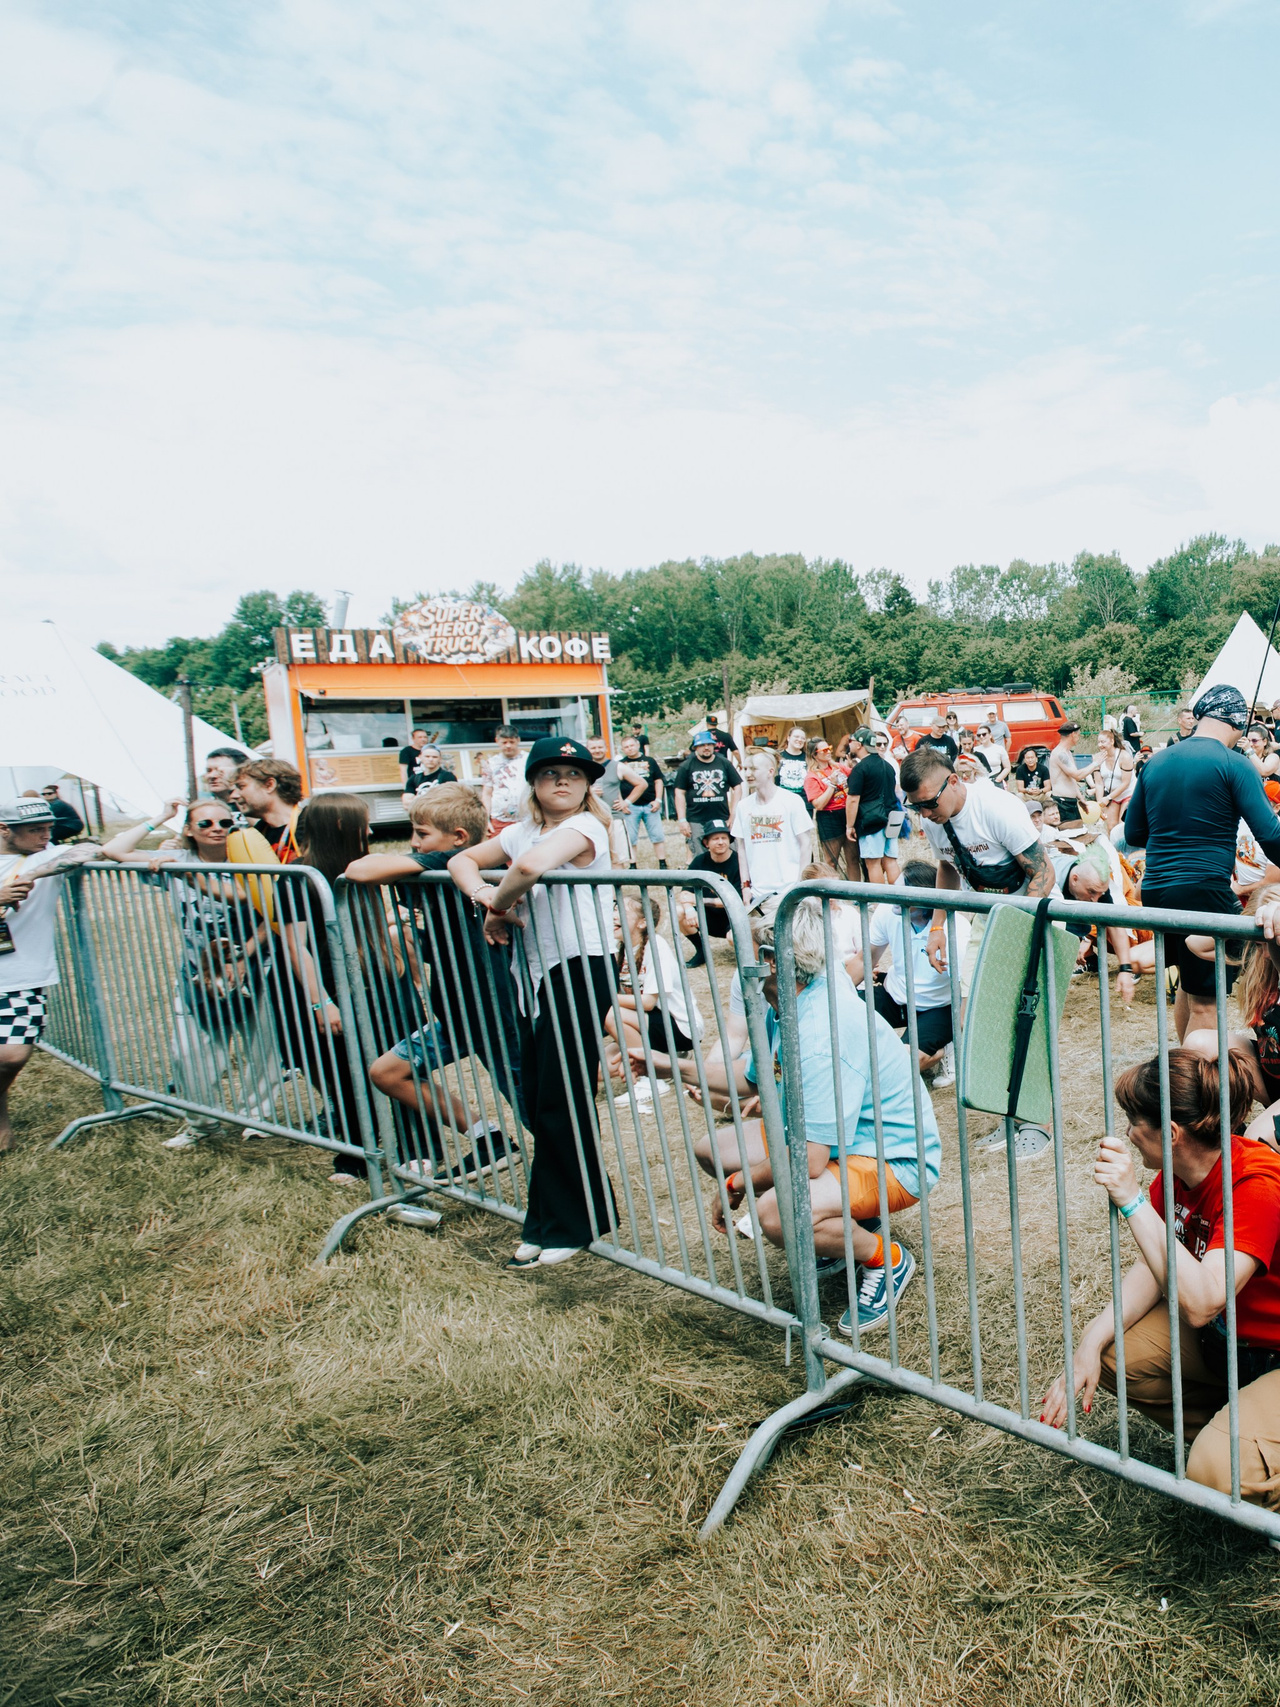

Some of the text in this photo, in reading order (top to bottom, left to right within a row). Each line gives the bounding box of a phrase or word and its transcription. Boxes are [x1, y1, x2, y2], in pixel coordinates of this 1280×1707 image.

[418, 604, 484, 627] SUPER
[429, 621, 480, 637] HERO
[290, 633, 395, 663] ЕДА
[425, 635, 486, 656] TRUCK
[519, 635, 611, 659] КОФЕ
